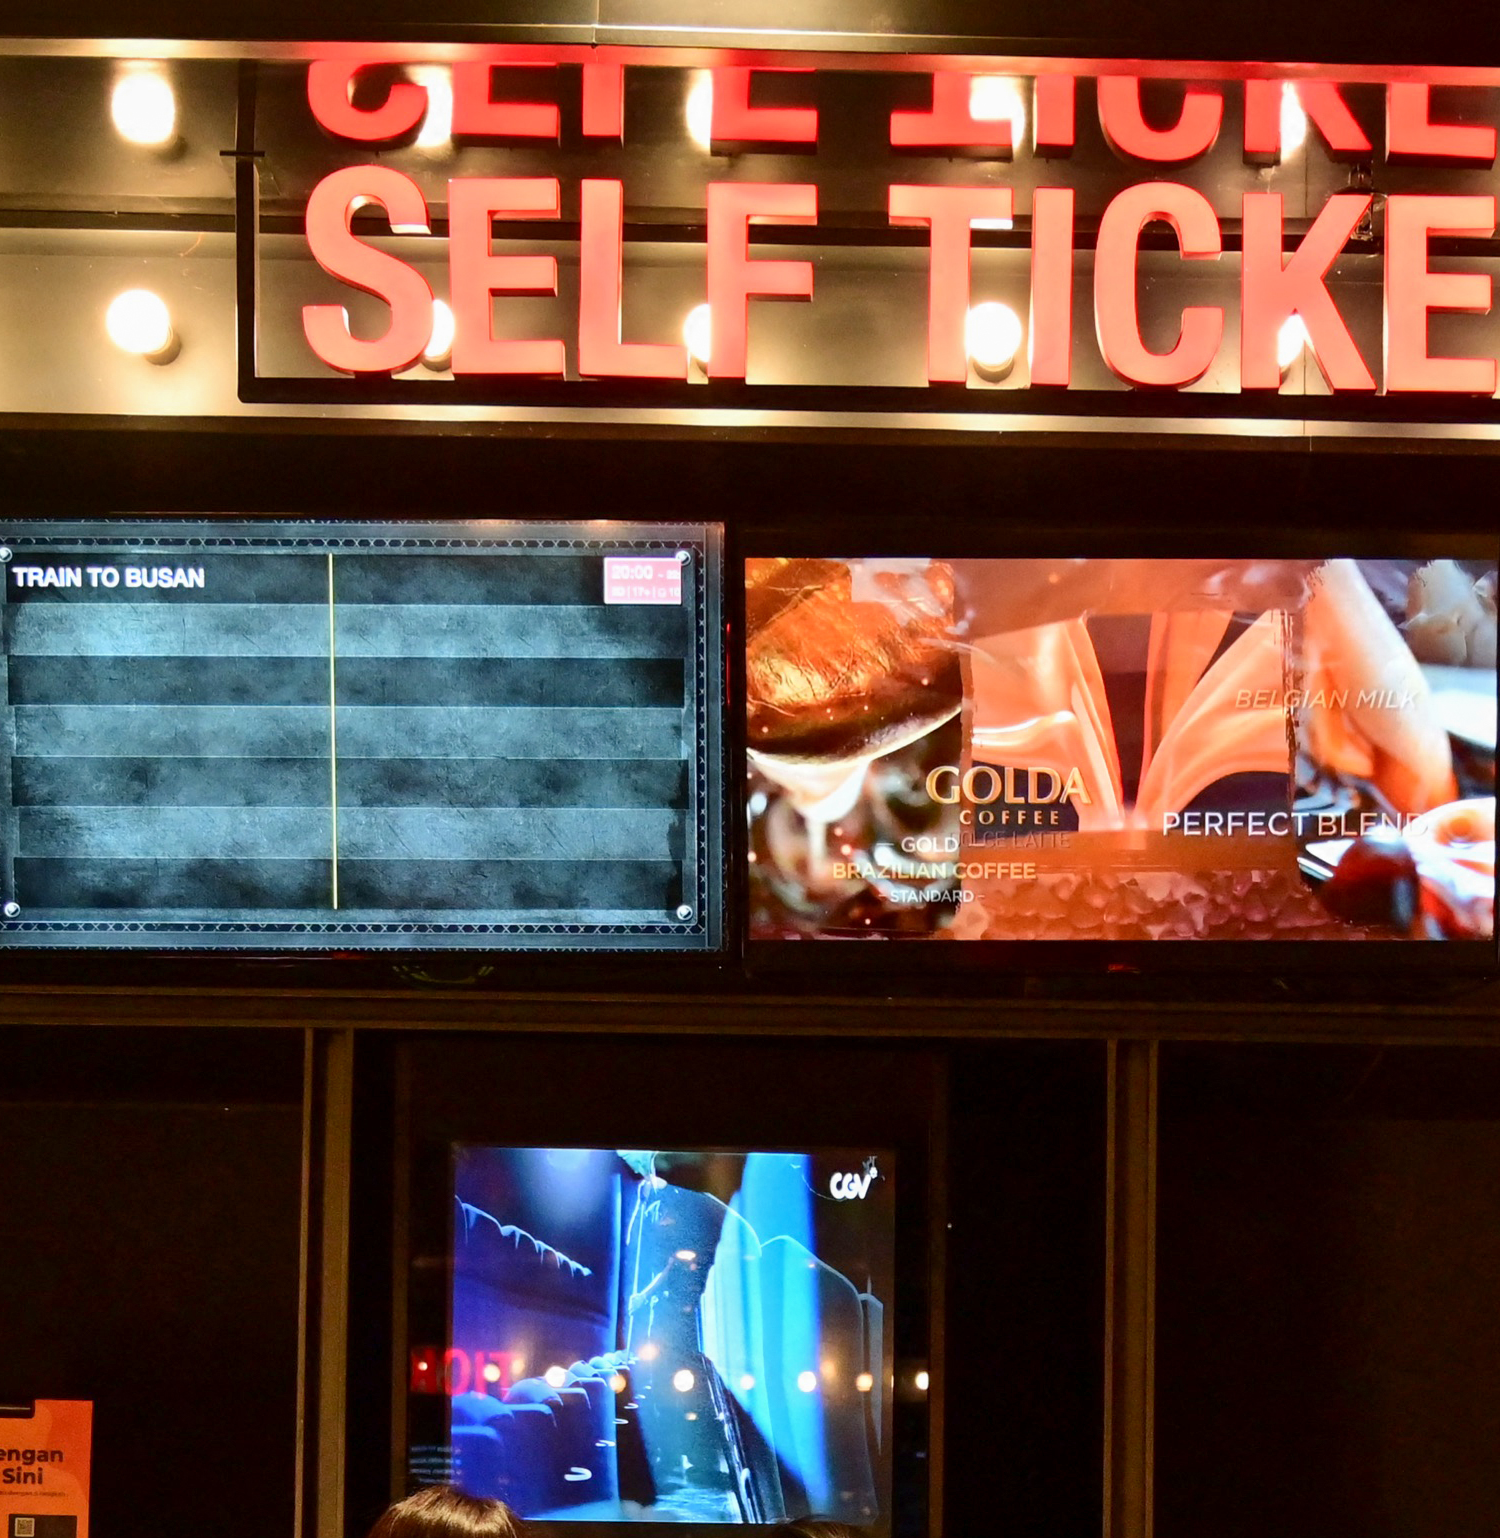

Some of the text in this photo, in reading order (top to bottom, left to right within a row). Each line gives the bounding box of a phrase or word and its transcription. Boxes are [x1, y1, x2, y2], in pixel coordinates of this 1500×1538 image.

[302, 163, 819, 381] SELF
[12, 566, 205, 588] TRAIN TO BUSAN
[1235, 689, 1420, 711] BELGIAN MILK
[925, 764, 1092, 806] GOLDA
[959, 808, 1060, 826] COFFEE
[1161, 811, 1431, 839] PERFECT BLEND
[900, 836, 958, 854] GOLD
[832, 862, 1037, 880] BRAZILIAN COFFEE
[889, 888, 975, 904] STANDARD
[829, 1172, 873, 1200] CGV
[2, 1466, 44, 1485] Sini
